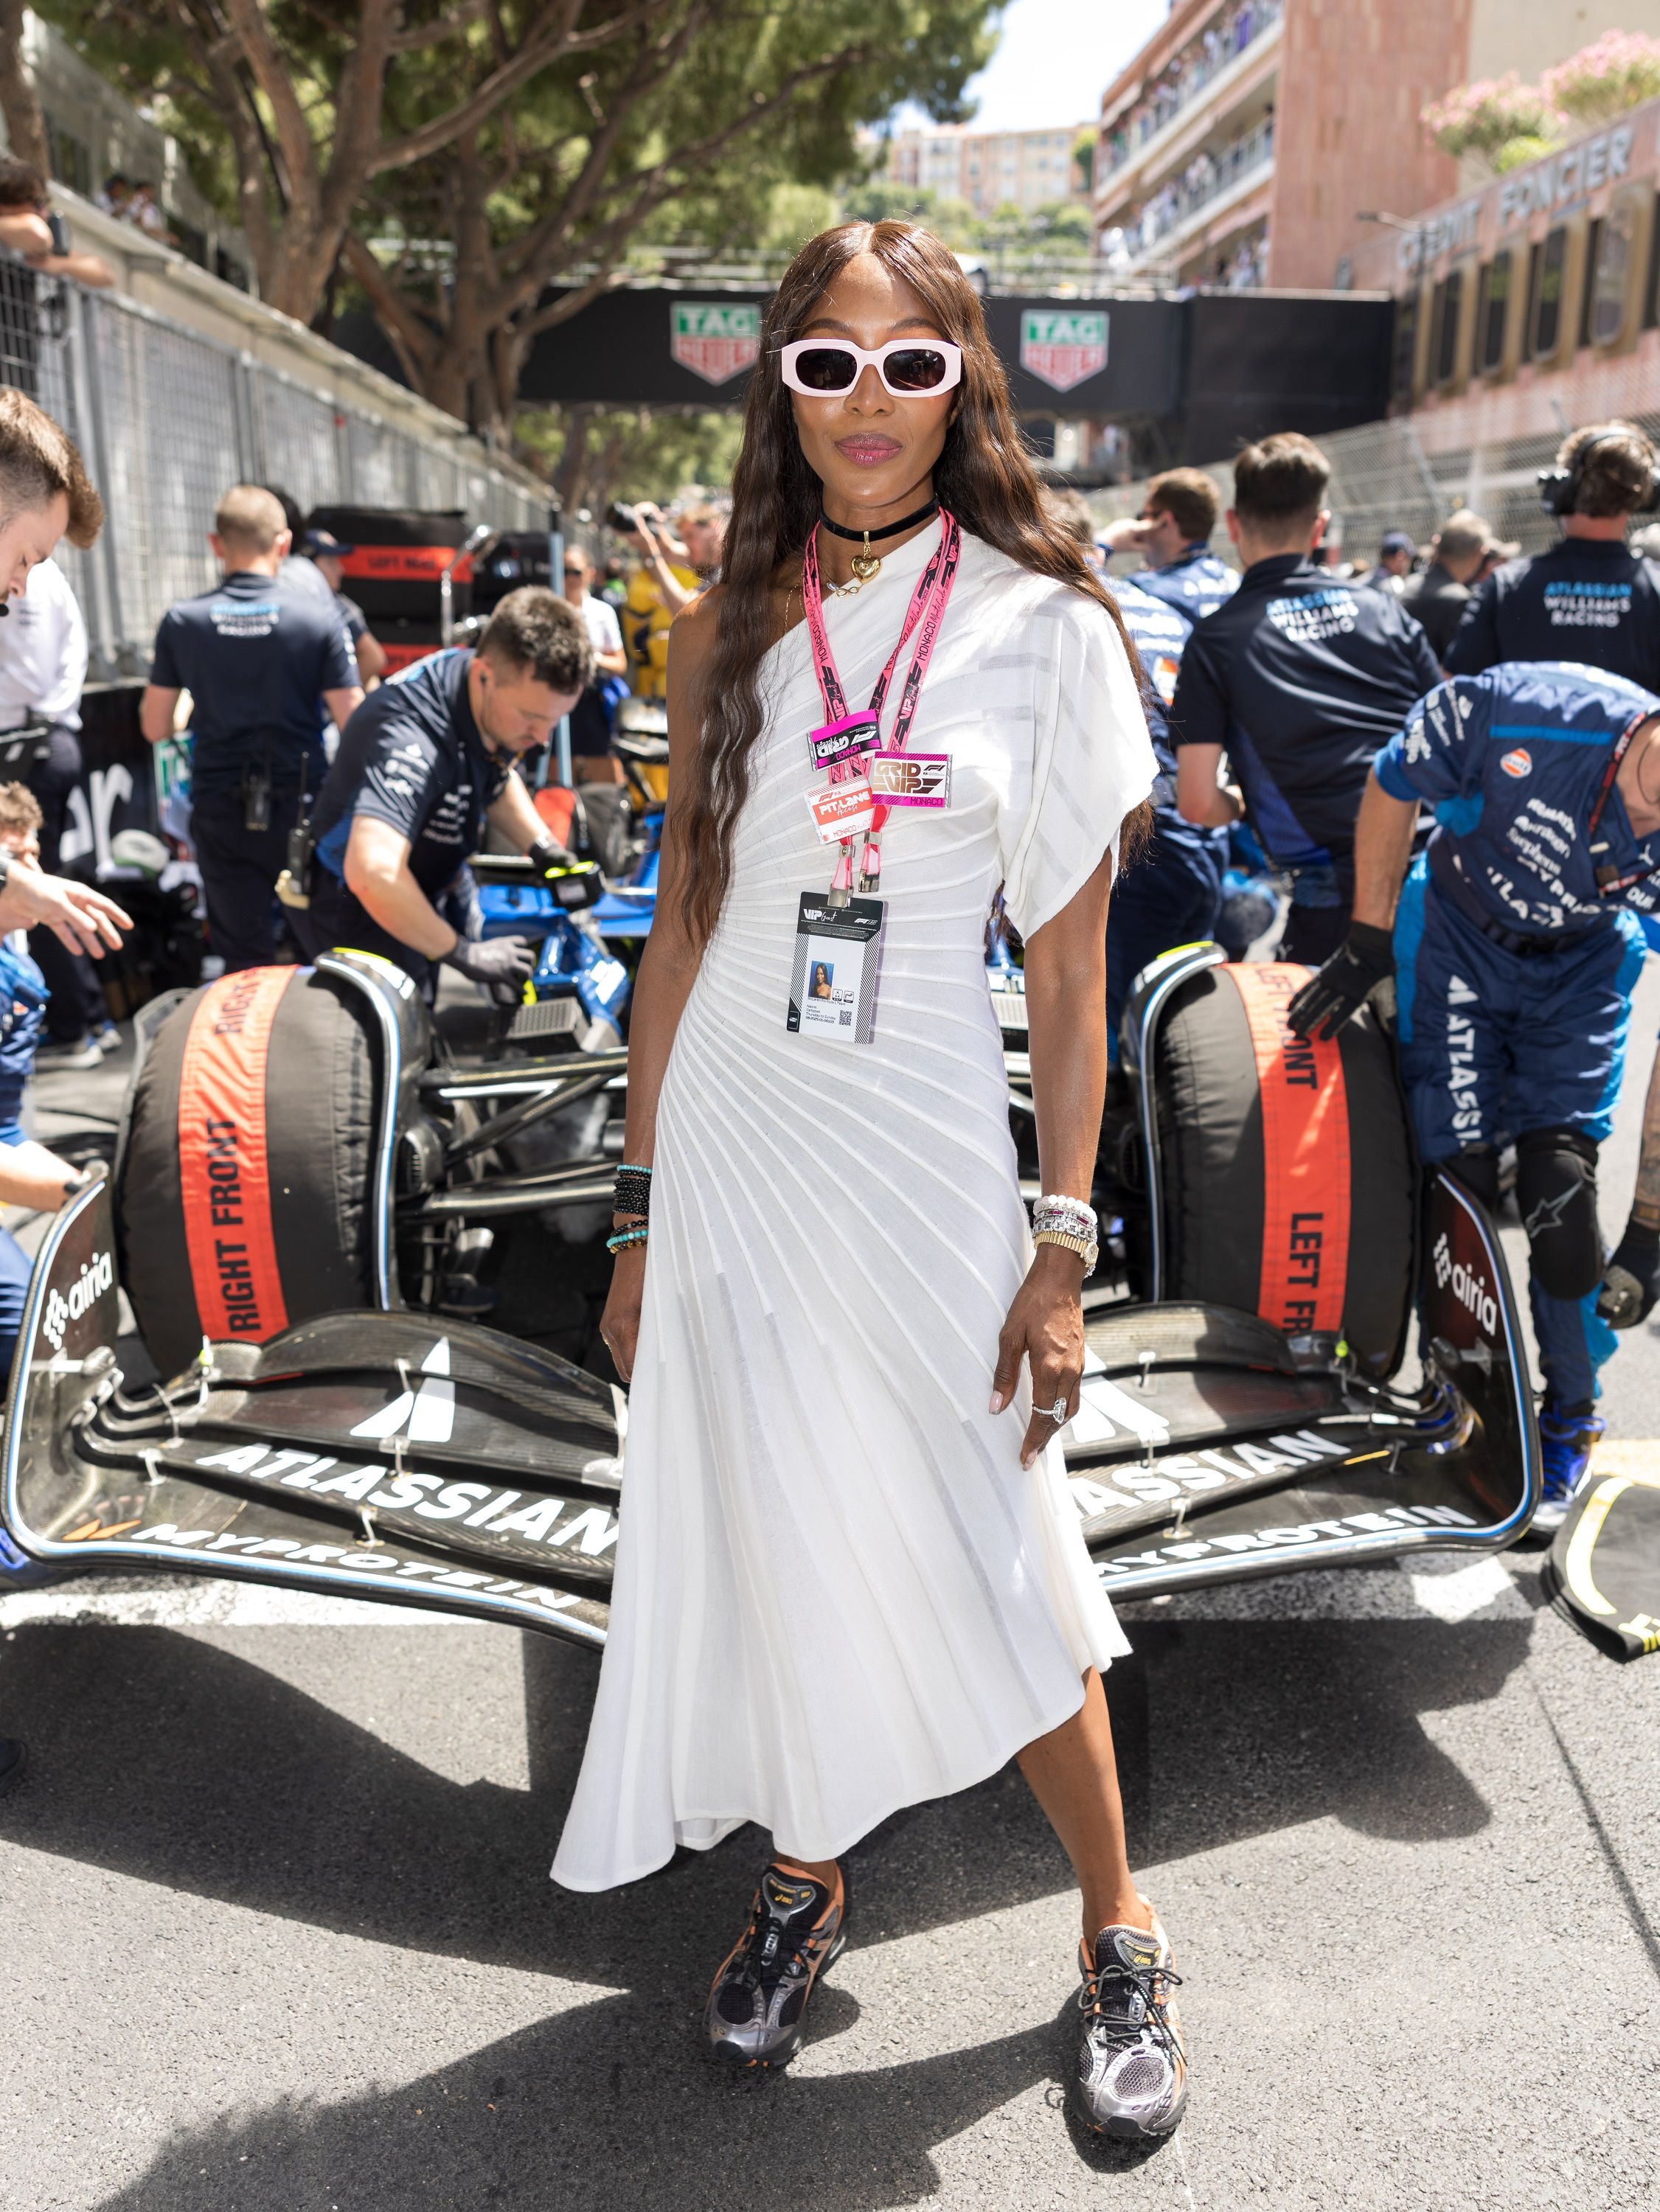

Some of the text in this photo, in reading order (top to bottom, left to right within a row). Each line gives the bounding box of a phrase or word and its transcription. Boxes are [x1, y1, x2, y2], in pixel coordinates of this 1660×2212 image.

[677, 307, 756, 337] TAG
[1027, 314, 1105, 344] TAG
[1268, 601, 1359, 629] WILLIAMS
[1543, 595, 1631, 613] WILLIAMS
[1551, 610, 1620, 627] RACING
[917, 622, 936, 661] MONACO
[1285, 616, 1355, 641] RACING
[813, 625, 828, 663] MONACO
[899, 699, 914, 720] VIP
[836, 744, 861, 760] MONACO
[876, 761, 921, 777] GRID
[884, 776, 922, 793] VIP
[819, 801, 838, 815] PIT
[833, 824, 857, 838] MONACO
[803, 908, 822, 920] VIP
[1446, 1013, 1483, 1147] ATLASSI
[206, 1117, 261, 1332] RIGHT FRONT
[1288, 1212, 1324, 1289] LEFT
[69, 1251, 113, 1320] airia
[1451, 1263, 1497, 1337] airia
[195, 1443, 619, 1556] ATLASSIAN
[132, 1523, 583, 1610] MYPROTEIN
